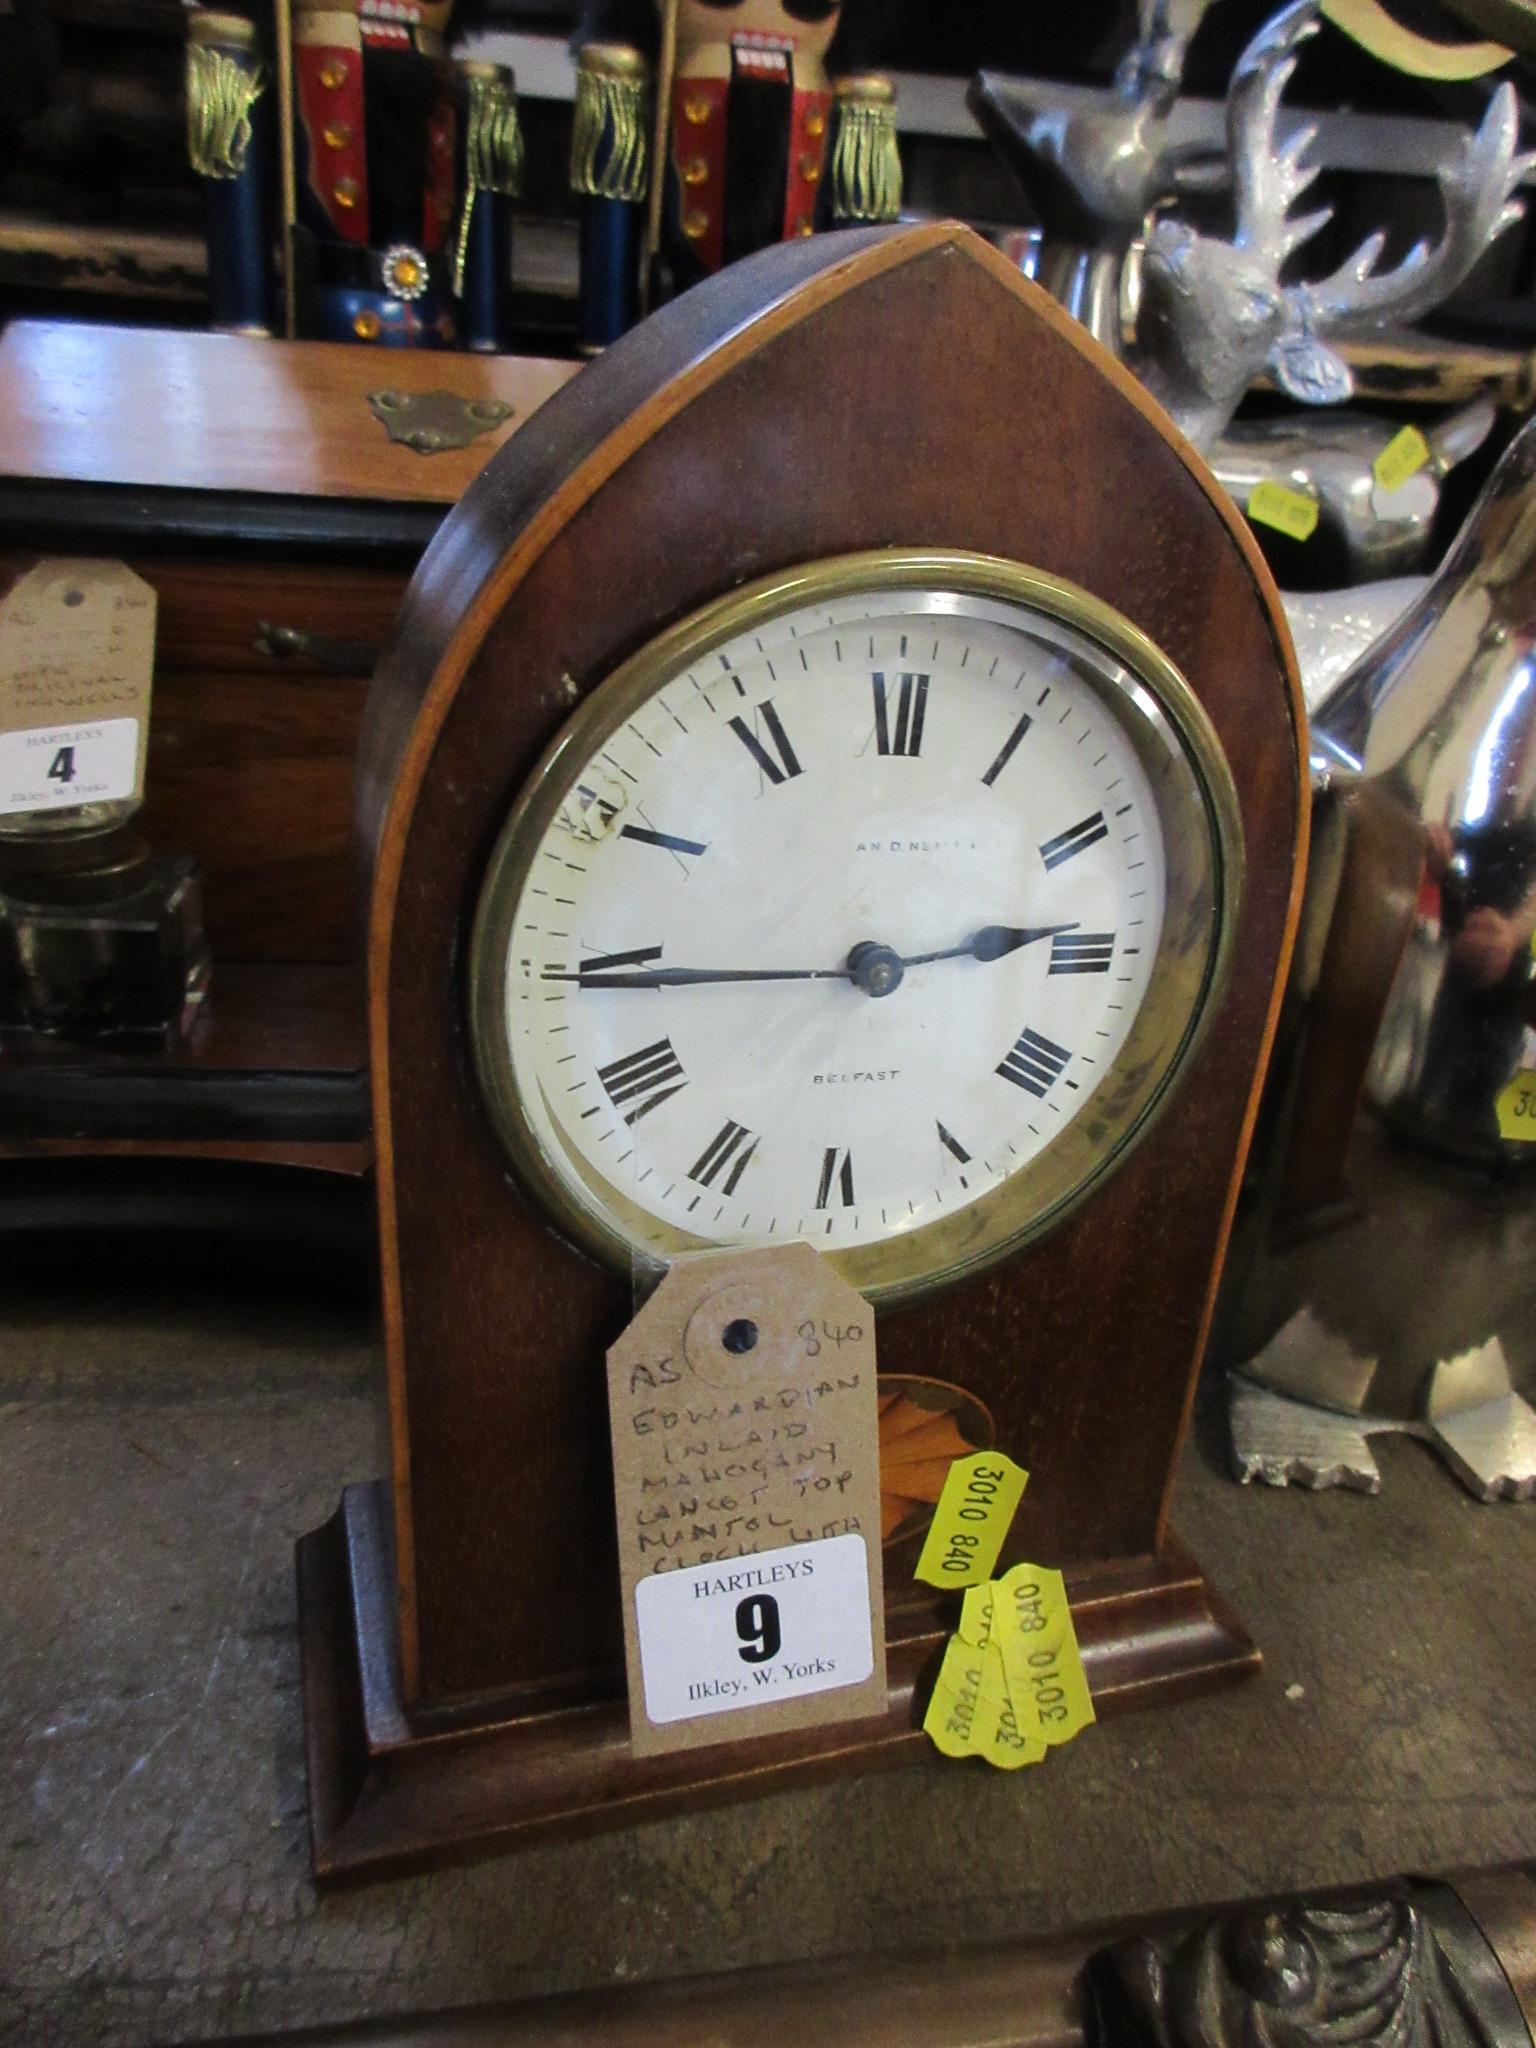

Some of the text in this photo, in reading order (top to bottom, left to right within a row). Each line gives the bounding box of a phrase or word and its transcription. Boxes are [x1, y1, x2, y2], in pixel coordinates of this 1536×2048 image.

[47, 746, 76, 783] 4
[813, 1070, 900, 1084] BELFAST
[798, 1320, 864, 1357] 840
[632, 1374, 860, 1436] EDWARDIAN
[664, 1423, 807, 1464] INLAID
[641, 1442, 837, 1493] MAHOGANY
[792, 1470, 852, 1497] TOP
[941, 1465, 1004, 1572] 3010 840
[693, 1558, 815, 1599] HARTLEYS
[735, 1593, 781, 1663] 9
[1013, 1583, 1068, 1724] 3010 840
[688, 1657, 837, 1701] Ilkley, W. Yorks
